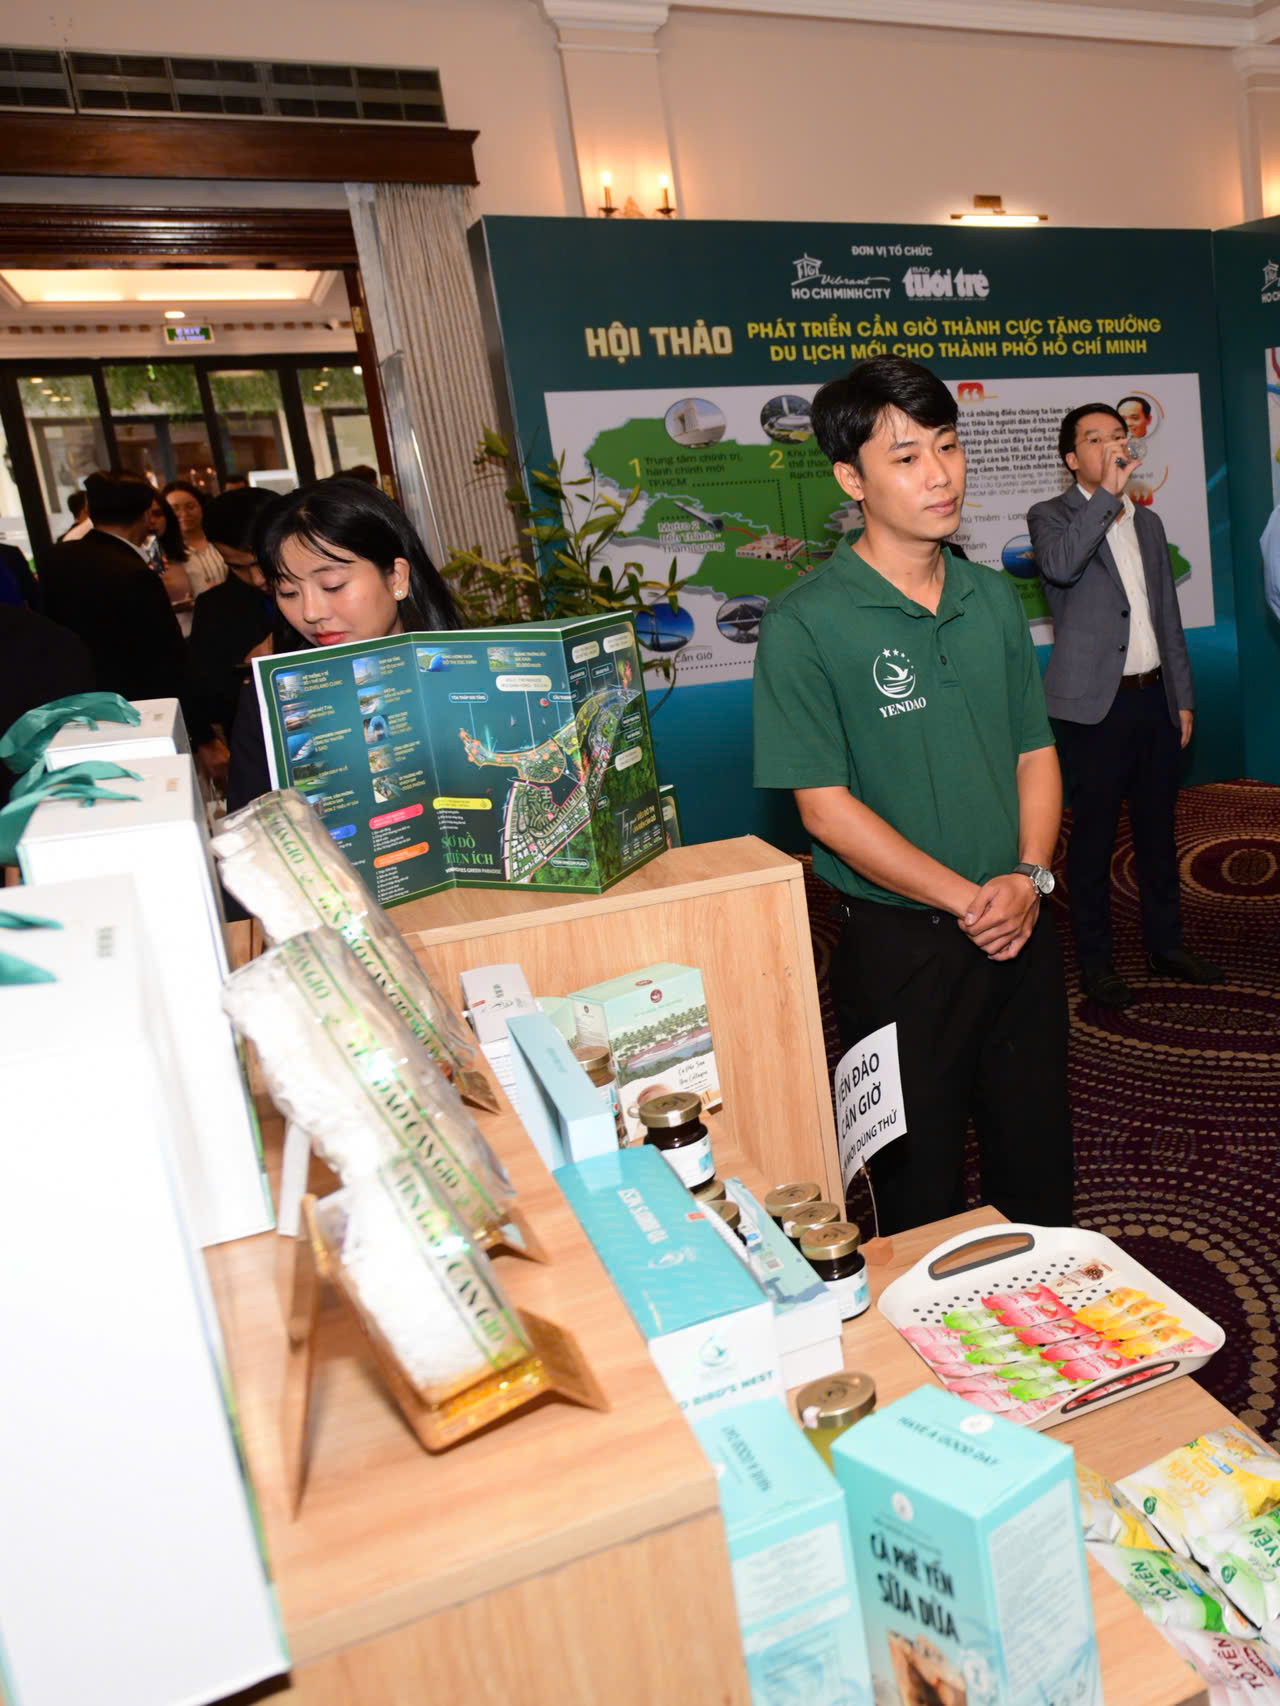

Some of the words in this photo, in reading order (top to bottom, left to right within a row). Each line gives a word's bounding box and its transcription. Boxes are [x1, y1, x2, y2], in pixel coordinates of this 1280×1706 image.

[791, 288, 812, 299] HO
[812, 288, 832, 299] CHI
[833, 288, 862, 299] MINH
[862, 287, 890, 299] CITY
[747, 318, 797, 338] PHÁT
[801, 313, 851, 338] TRIỂN
[858, 314, 897, 337] CẦN
[903, 316, 938, 337] GIỜ
[942, 316, 1000, 335] THÀNH
[1005, 318, 1043, 339] CỰC
[1048, 315, 1093, 335] TĂNG
[1096, 313, 1161, 334] TRƯỞNG
[584, 321, 641, 364] HỘI
[649, 319, 733, 356] THẢO
[770, 345, 797, 361] DU
[803, 345, 845, 365] LỊCH
[893, 342, 934, 358] CHO
[939, 339, 997, 358] THÀNH
[1002, 335, 1039, 356] PHỐ
[1042, 335, 1067, 356] HỒ
[1072, 336, 1102, 355] CHÍ
[1106, 340, 1146, 354] MINH
[628, 458, 641, 478] 1
[768, 449, 785, 469] 2
[879, 697, 927, 718] YENDAO
[852, 1053, 880, 1087] ĐẢO
[858, 1081, 882, 1115] GIỜ
[857, 1126, 878, 1152] DÙNG
[878, 1109, 897, 1132] THỬ
[1248, 1527, 1279, 1558] YẾN
[924, 1559, 955, 1600] YẾN
[1130, 1561, 1160, 1588] YẾN
[1212, 1636, 1243, 1670] YẾN
